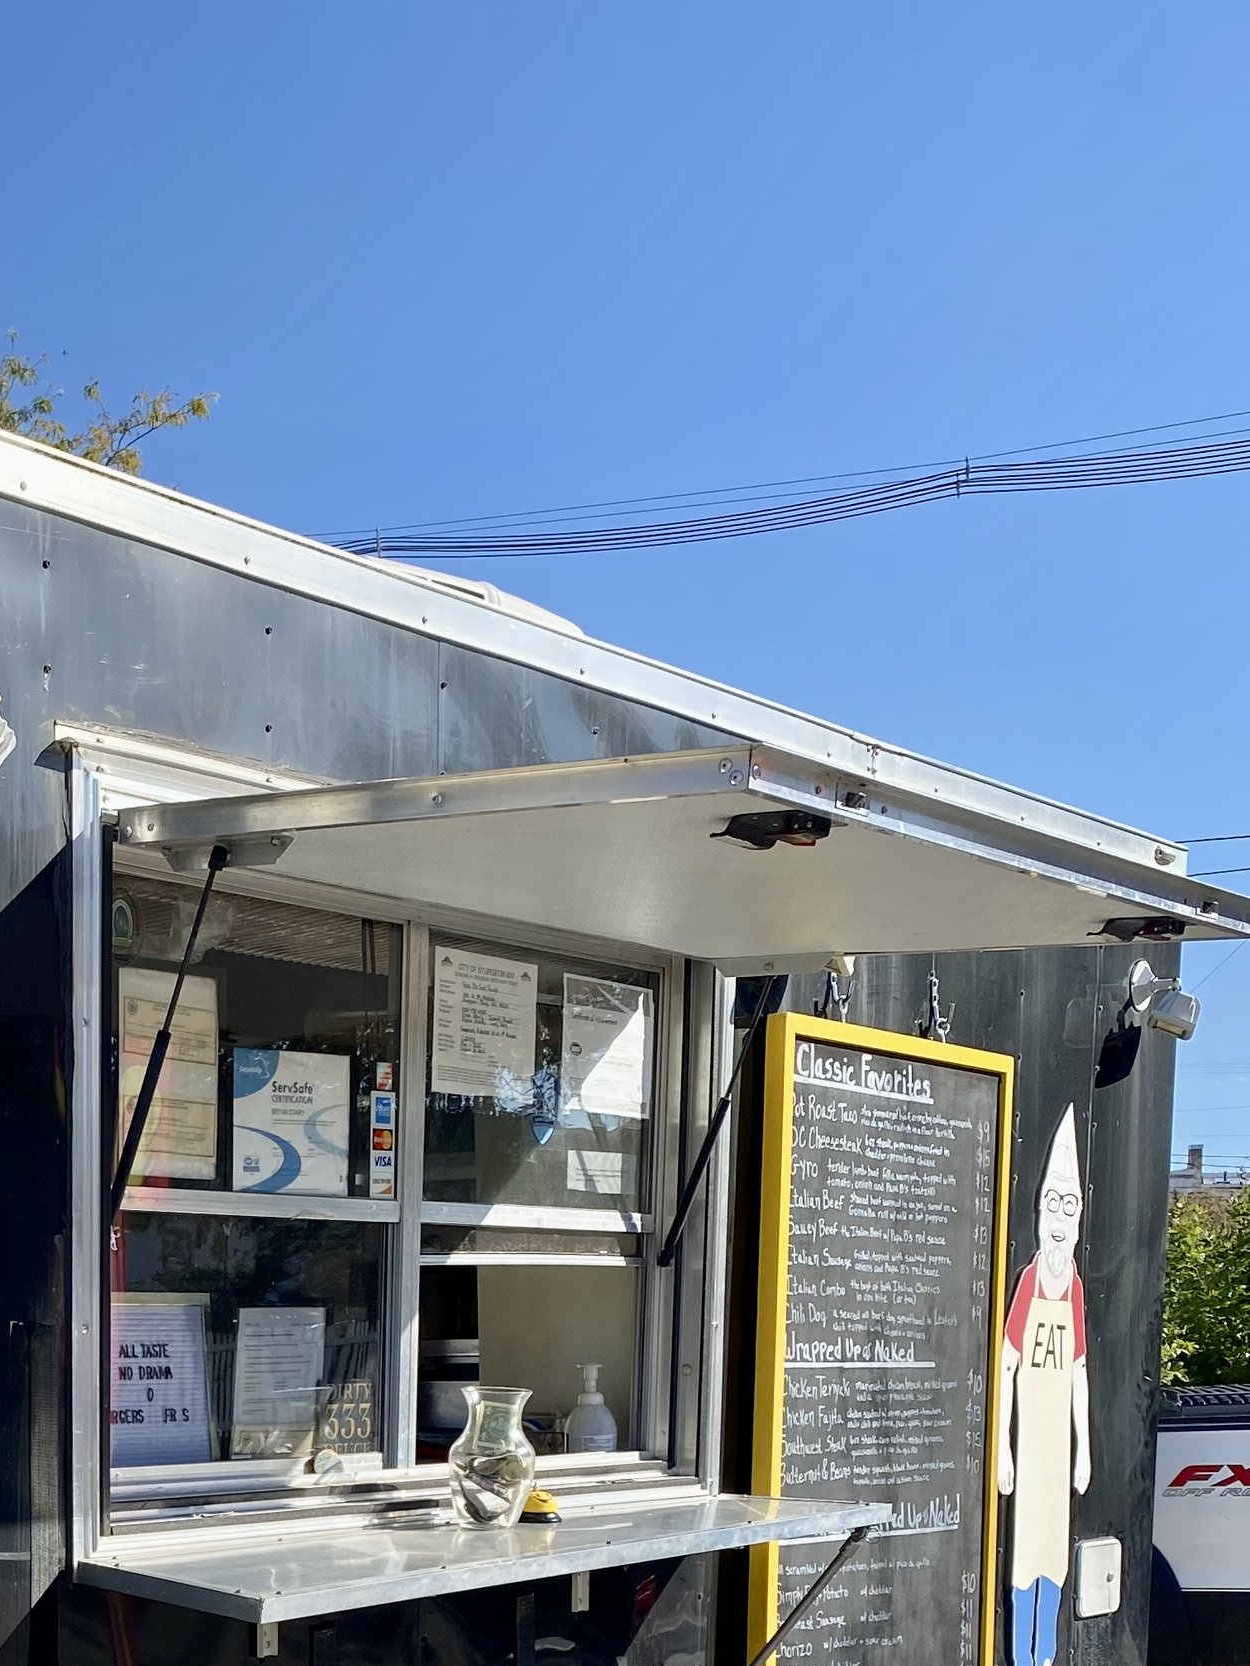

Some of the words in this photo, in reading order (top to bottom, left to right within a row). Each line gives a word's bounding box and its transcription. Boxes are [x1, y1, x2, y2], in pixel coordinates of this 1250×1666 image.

[796, 1043, 856, 1085] Classic
[861, 1053, 931, 1098] Favorites
[271, 1081, 314, 1095] ServSafe
[271, 1094, 313, 1104] CERTIFICATION
[808, 1094, 838, 1121] Roast
[837, 1102, 858, 1124] Taco
[977, 1120, 990, 1143] $9
[374, 1156, 392, 1167] VISA
[976, 1145, 990, 1168] $15
[791, 1153, 818, 1180] Gyro
[976, 1171, 990, 1193] $12
[822, 1188, 844, 1210] Beef
[975, 1196, 990, 1215] $12
[819, 1217, 838, 1238] Beef
[973, 1223, 988, 1245] $13
[973, 1250, 986, 1271] $12
[787, 1274, 818, 1297] Italian
[820, 1278, 846, 1297] Combo
[972, 1279, 986, 1297] $13
[808, 1302, 828, 1329] Dog
[971, 1304, 982, 1330] $9
[118, 1344, 139, 1358] ALL
[140, 1343, 170, 1358] TASTE
[785, 1330, 842, 1362] Wrapped
[845, 1337, 862, 1361] Up
[1030, 1322, 1066, 1370] EAT
[118, 1366, 134, 1381] NO
[138, 1365, 173, 1380] DRAMA
[966, 1368, 983, 1396] $10
[326, 1383, 372, 1400] DIRTY
[324, 1402, 372, 1440] 333
[818, 1405, 845, 1431] Fajita
[965, 1398, 982, 1426] $13
[965, 1430, 981, 1450] $15
[821, 1457, 829, 1480] &
[965, 1453, 980, 1476] $10
[1162, 1487, 1215, 1497] OFF
[907, 1502, 922, 1529] Up
[961, 1569, 976, 1594] $10
[960, 1598, 973, 1618] $11
[776, 1641, 813, 1658] horizo
[960, 1619, 972, 1638] $11
[959, 1639, 972, 1660] $11
